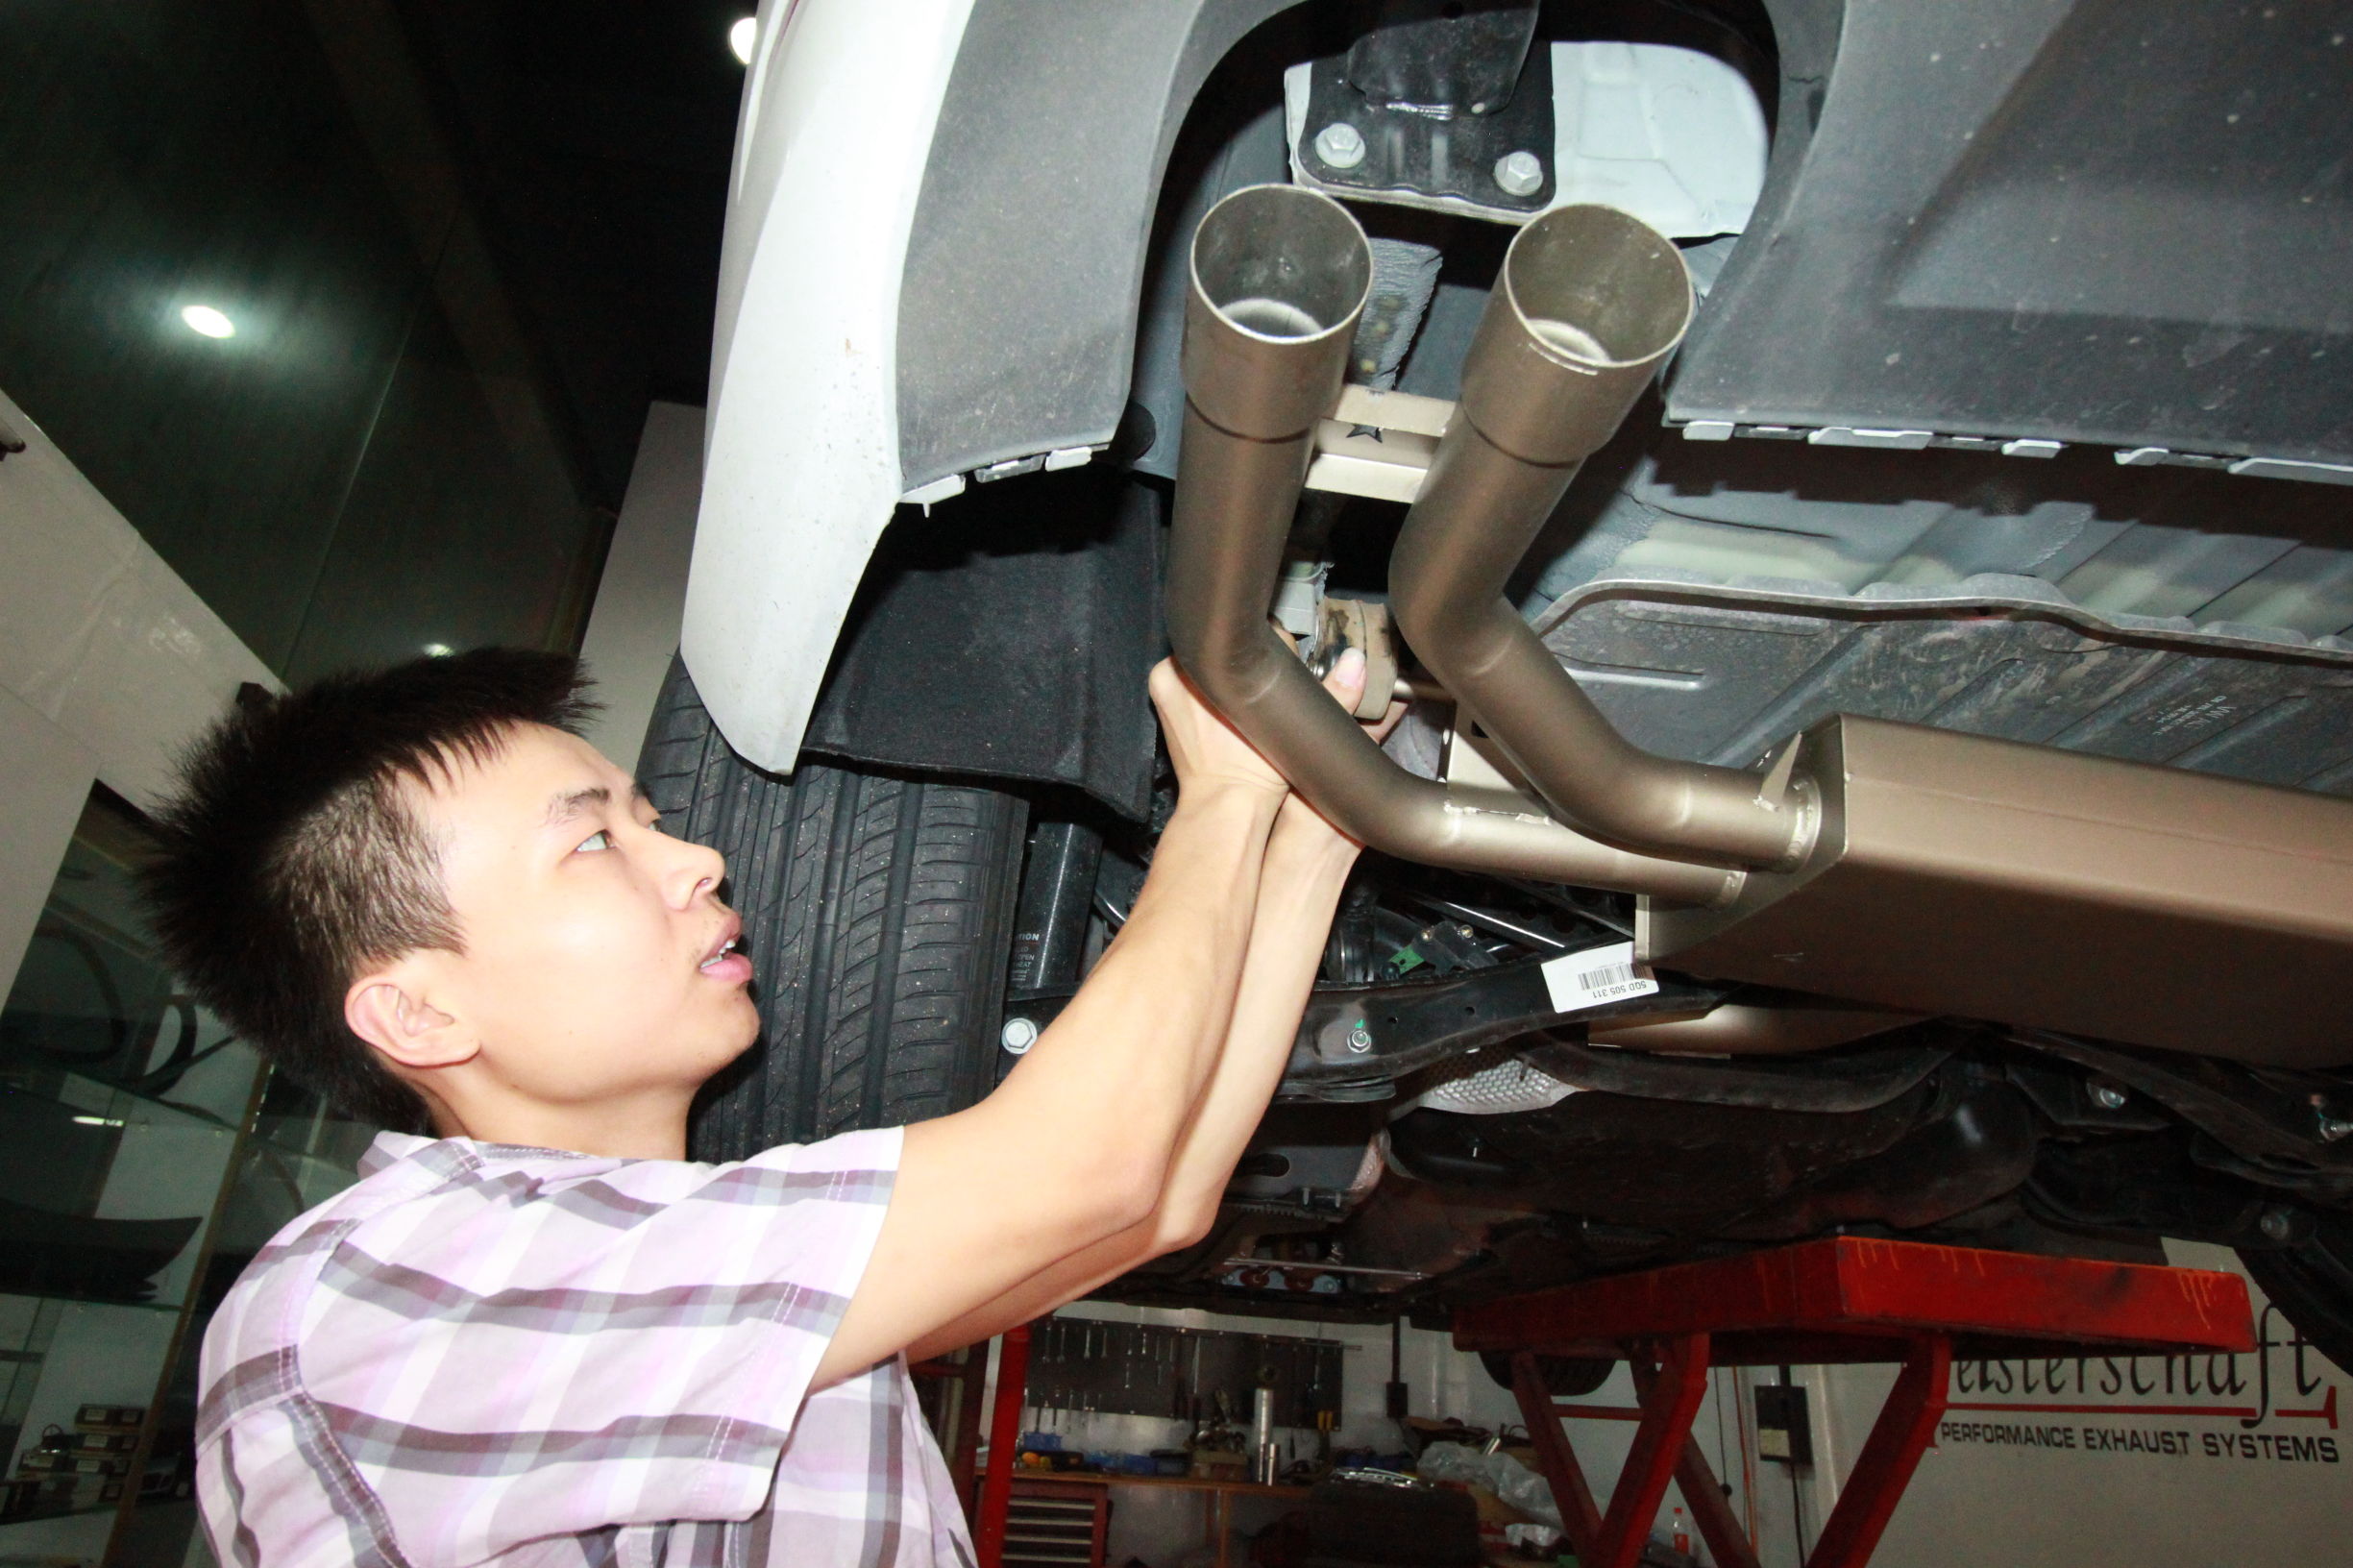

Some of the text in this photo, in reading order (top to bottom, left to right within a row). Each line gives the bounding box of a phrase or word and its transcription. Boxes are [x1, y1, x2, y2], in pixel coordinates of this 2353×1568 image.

[1592, 990, 1607, 999] 311
[1610, 985, 1627, 995] 505
[1940, 1421, 2340, 1463] PERFORMANCE EXHAUST SYSTEMS
